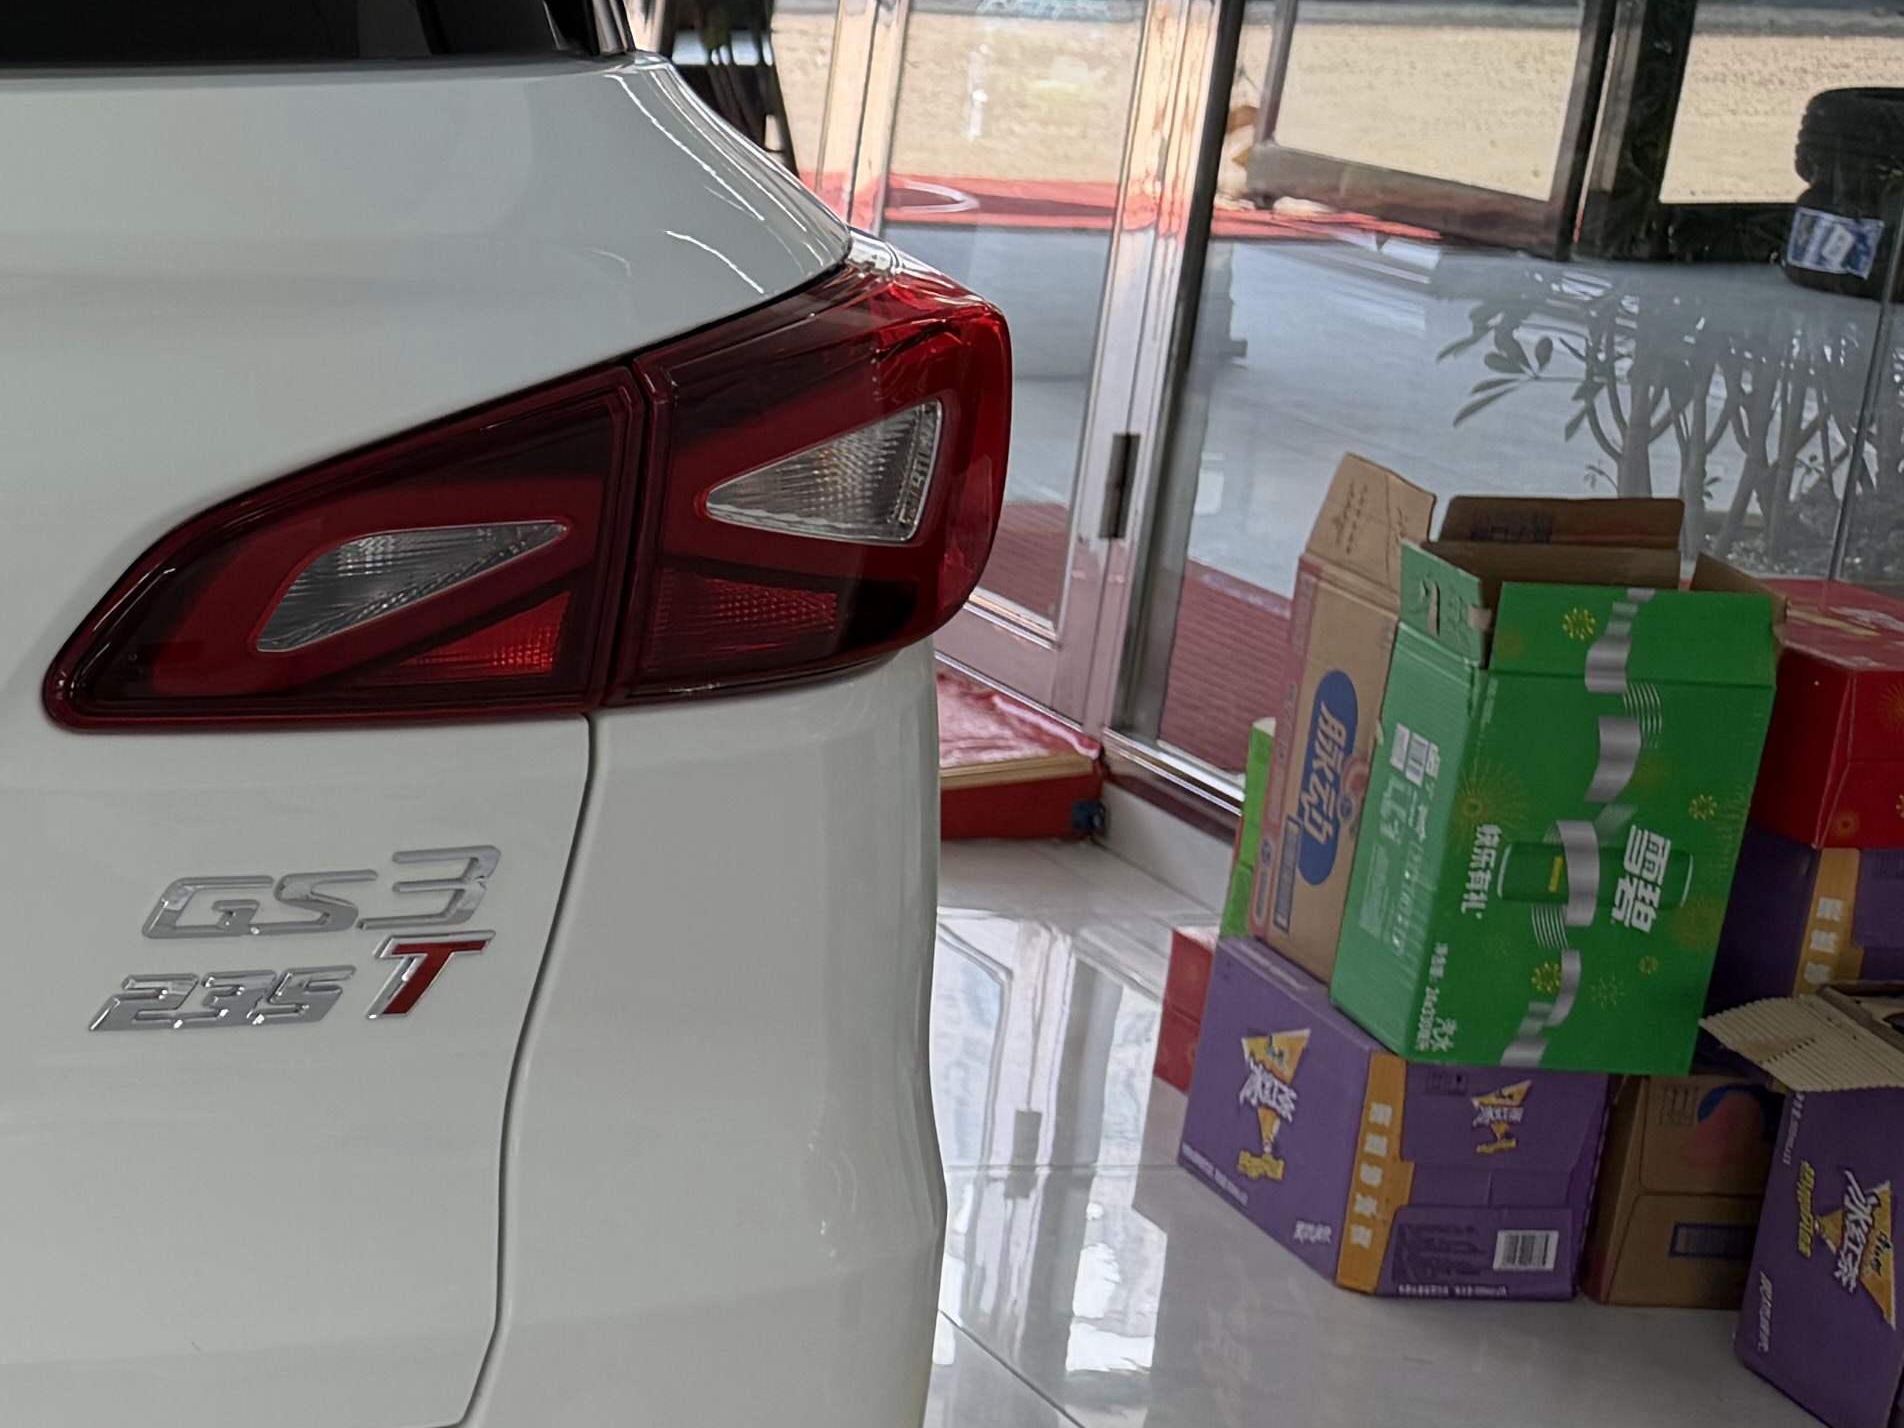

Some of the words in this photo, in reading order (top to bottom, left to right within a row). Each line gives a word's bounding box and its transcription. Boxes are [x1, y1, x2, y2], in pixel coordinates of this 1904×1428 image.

[1298, 702, 1348, 846] 脉动
[141, 844, 502, 940] GS3
[1610, 824, 1672, 935] 雪碧
[87, 928, 497, 1033] 235T
[1832, 1168, 1884, 1296] 冰红茶
